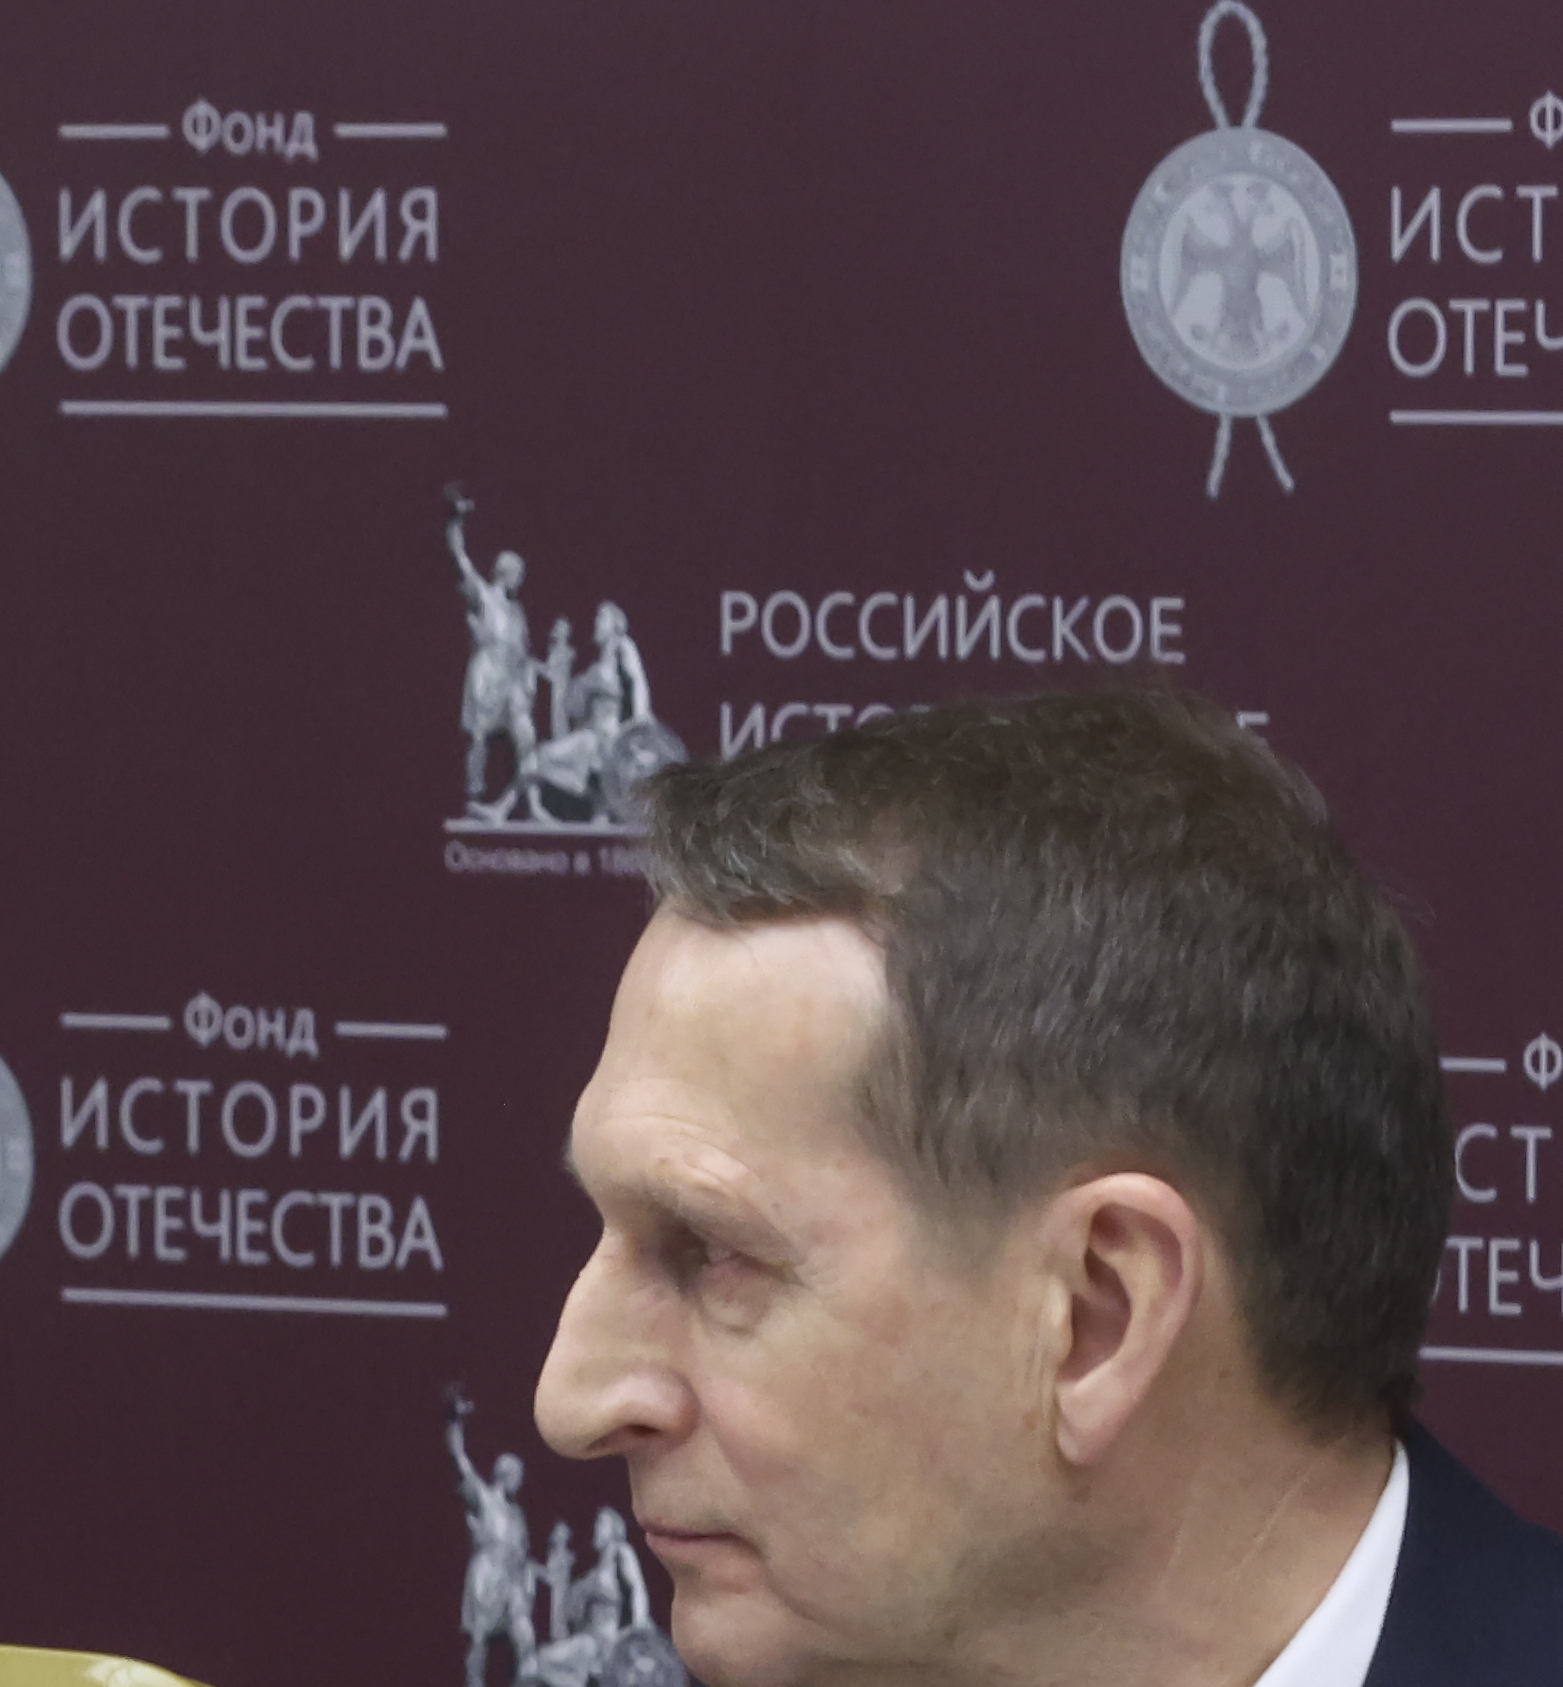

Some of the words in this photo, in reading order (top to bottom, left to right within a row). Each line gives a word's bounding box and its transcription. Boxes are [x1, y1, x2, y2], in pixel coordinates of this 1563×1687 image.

[181, 96, 319, 163] Фонд
[59, 185, 440, 264] ИСТОРИЯ
[1389, 184, 1561, 263] ИСТ
[56, 294, 445, 371] ОТЕЧЕСТВА
[1387, 297, 1563, 378] ОТЕЧ
[720, 569, 1187, 664] РОССИЙСКОЕ
[183, 990, 319, 1059] Фонд
[60, 1075, 439, 1163] ИСТОРИЯ
[1454, 1122, 1553, 1203] СТ
[58, 1181, 444, 1271] ОТЕЧЕСТВА
[1433, 1236, 1563, 1316] ТЕЧ
